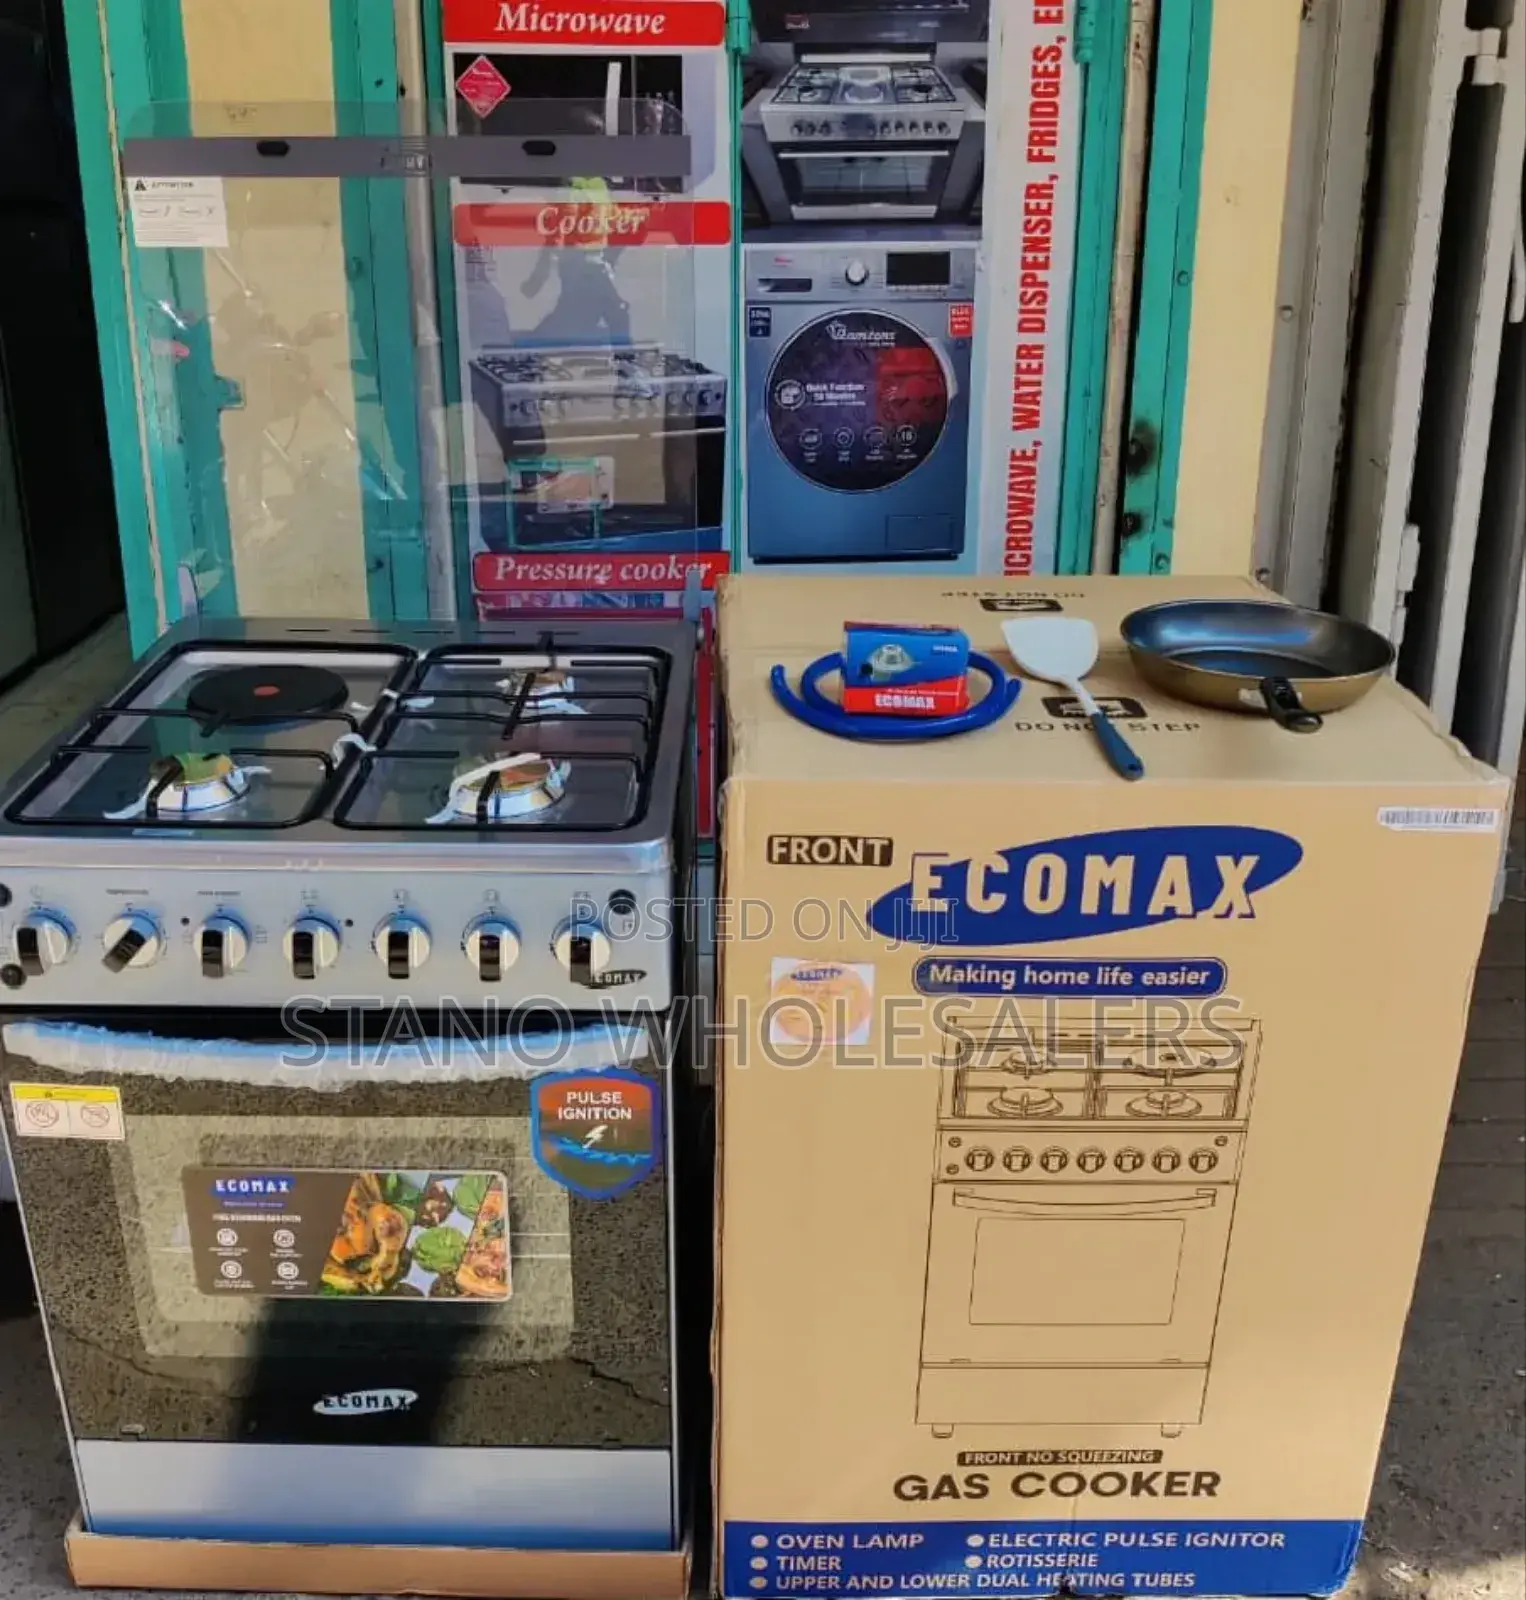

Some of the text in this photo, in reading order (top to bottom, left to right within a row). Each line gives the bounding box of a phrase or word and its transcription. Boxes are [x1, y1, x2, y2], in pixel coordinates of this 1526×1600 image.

[494, 2, 667, 36] Microwave
[1027, 35, 1067, 164] FRIDGES,
[536, 204, 650, 236] Cooker
[1016, 174, 1059, 334] DISPENSER,
[1012, 343, 1045, 432] WATER
[495, 556, 613, 582] Pressure
[1014, 721, 1055, 732] DO
[1127, 721, 1201, 733] STEP
[769, 837, 890, 865] FRONT
[910, 852, 1259, 919] ECOMAX
[929, 963, 1211, 988] Making home life easier
[566, 1091, 623, 1105] PULSE
[557, 1107, 632, 1120] IGNITION
[215, 1178, 290, 1193] ECOMAX
[323, 1394, 410, 1412] ECOMAX
[964, 1450, 1155, 1464] FRONT NO SQUEEZING
[893, 1471, 1221, 1501] GAS COOKER
[775, 1534, 925, 1549] OVEN LAMP
[988, 1532, 1286, 1548] ELECTRIC PULSE IGNITOR
[776, 1555, 842, 1571] TIMER
[986, 1553, 1099, 1568] ROTISSERIE
[776, 1572, 1196, 1590] UPPER AND LOWER DUAL HEATING TUBES
